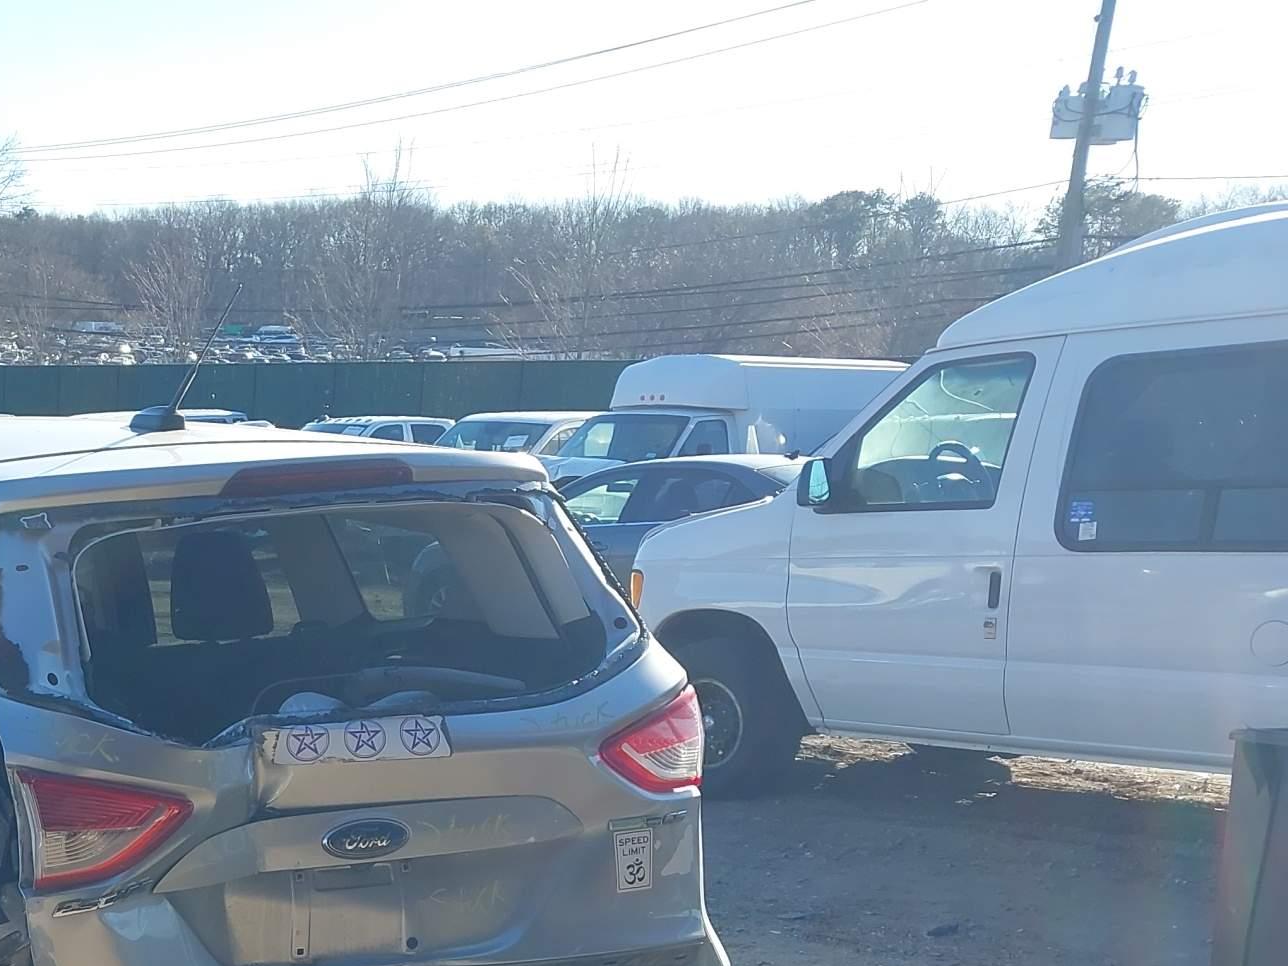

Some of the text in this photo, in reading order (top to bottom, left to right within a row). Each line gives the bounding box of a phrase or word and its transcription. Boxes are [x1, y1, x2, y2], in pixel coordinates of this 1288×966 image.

[343, 831, 393, 850] Ford
[618, 836, 649, 847] SPEED
[622, 846, 646, 857] LIMIT
